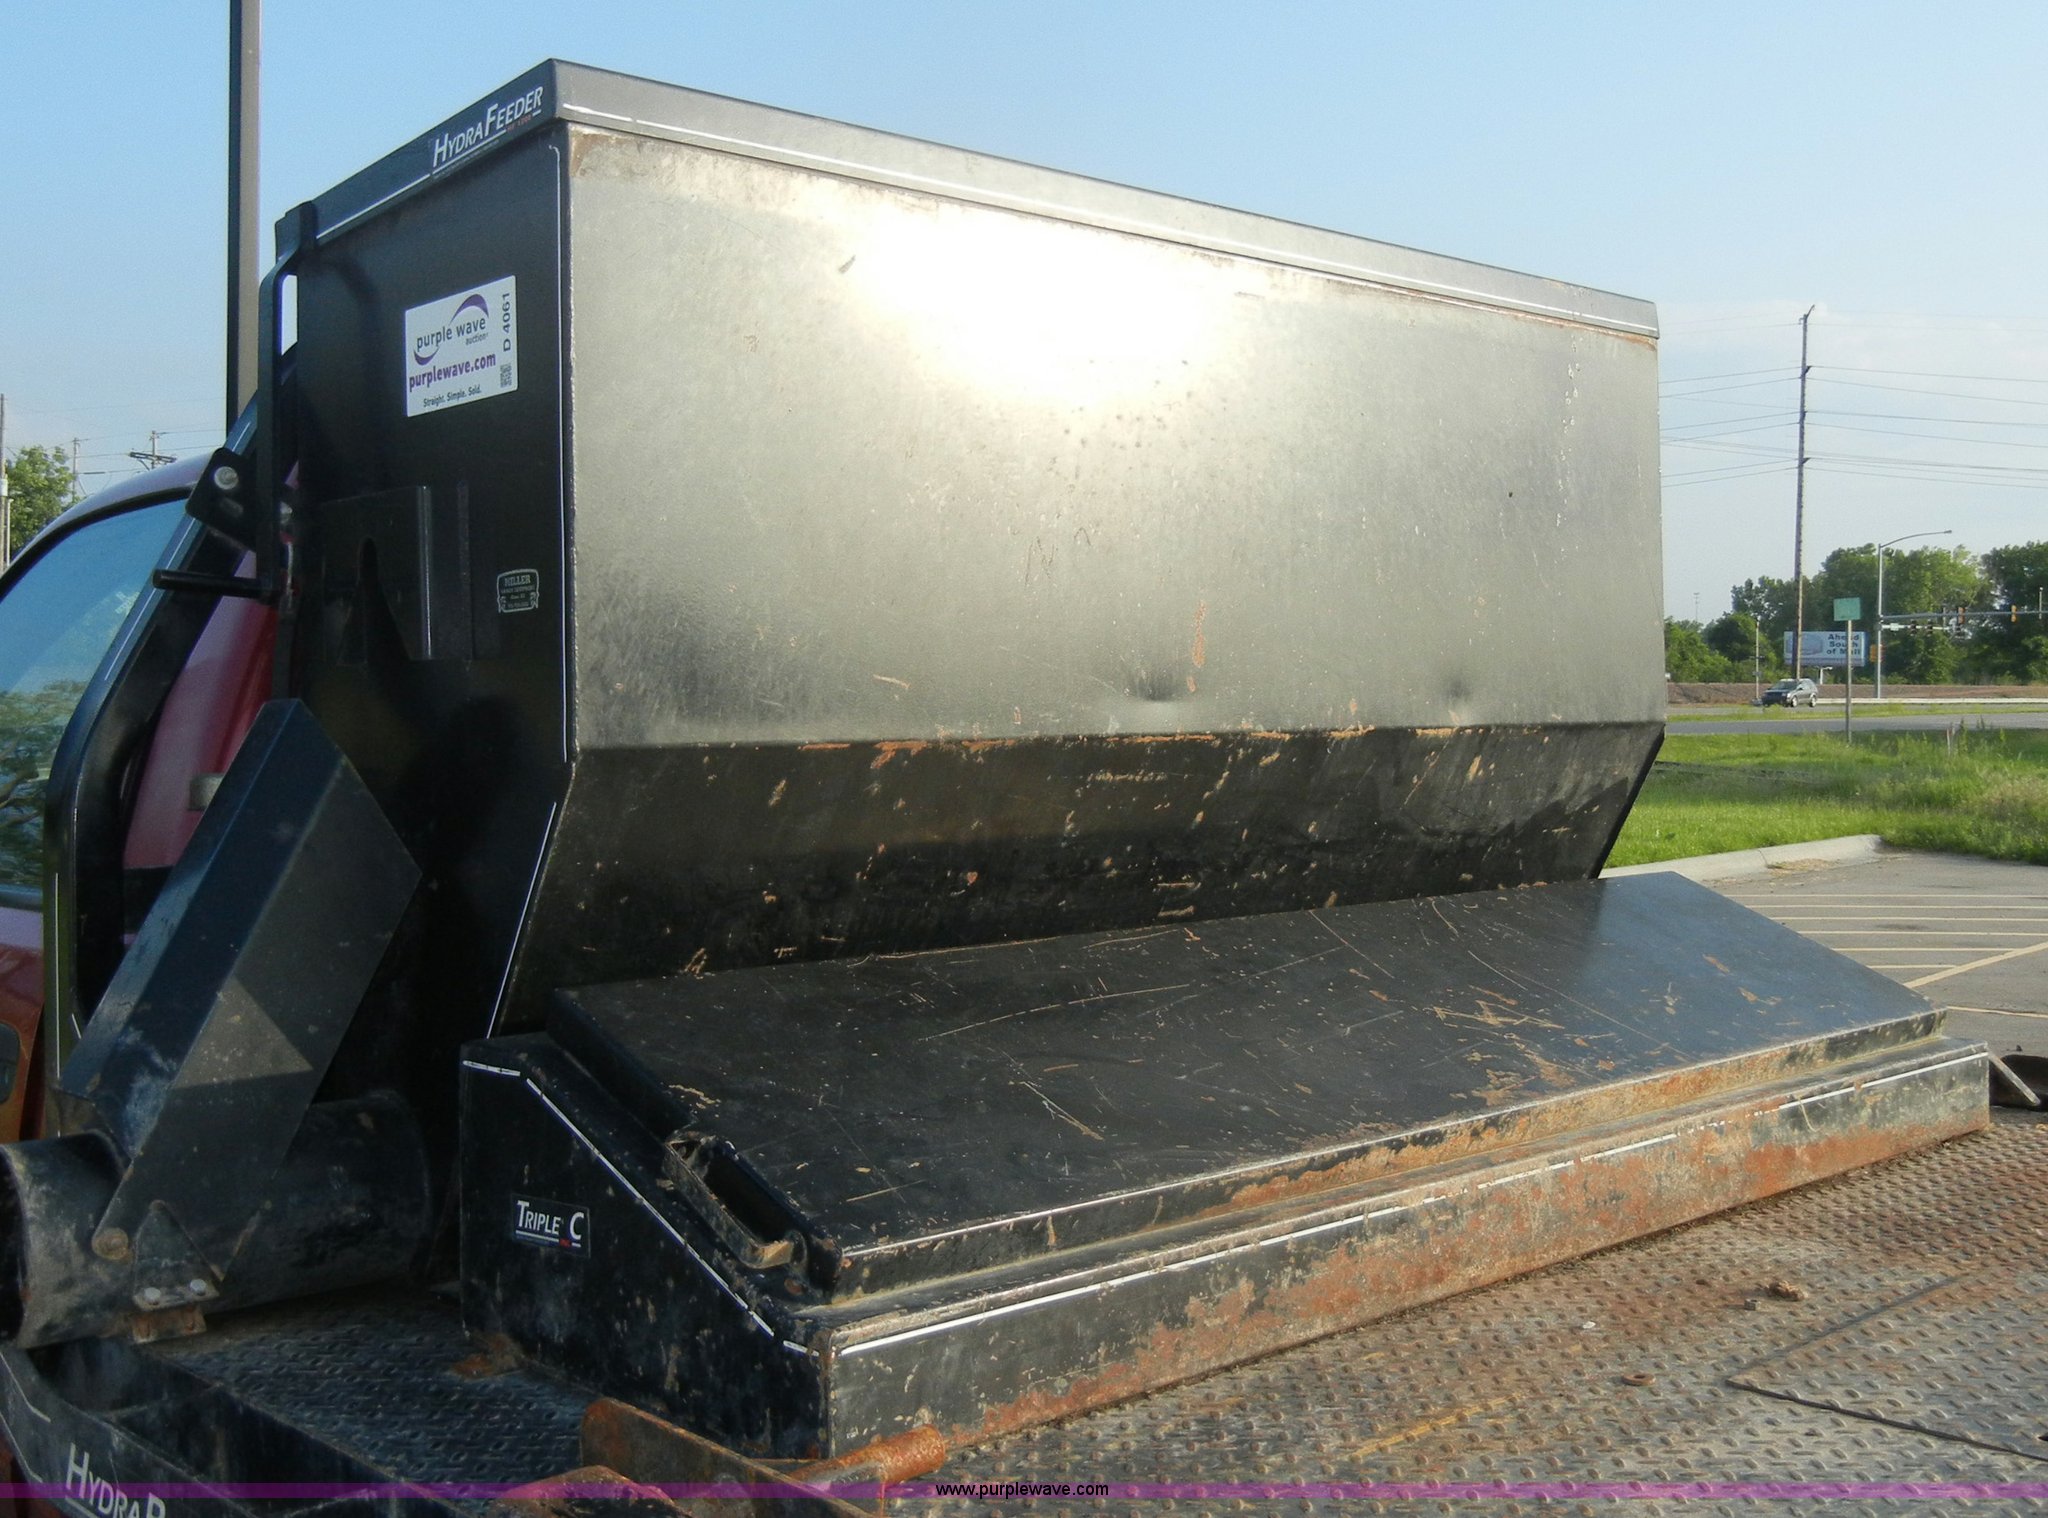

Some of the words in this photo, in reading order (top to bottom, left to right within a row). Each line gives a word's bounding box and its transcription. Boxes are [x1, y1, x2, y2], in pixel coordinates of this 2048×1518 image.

[502, 293, 511, 334] 4061
[416, 326, 453, 353] purple
[456, 318, 486, 338] wave
[503, 339, 511, 352] D
[409, 353, 496, 393] purplewave.com
[423, 394, 446, 408] Straight.
[447, 390, 467, 402] Simple.
[468, 384, 482, 396] Sold.
[517, 1200, 562, 1236] TRIPLE
[569, 1211, 585, 1241] C
